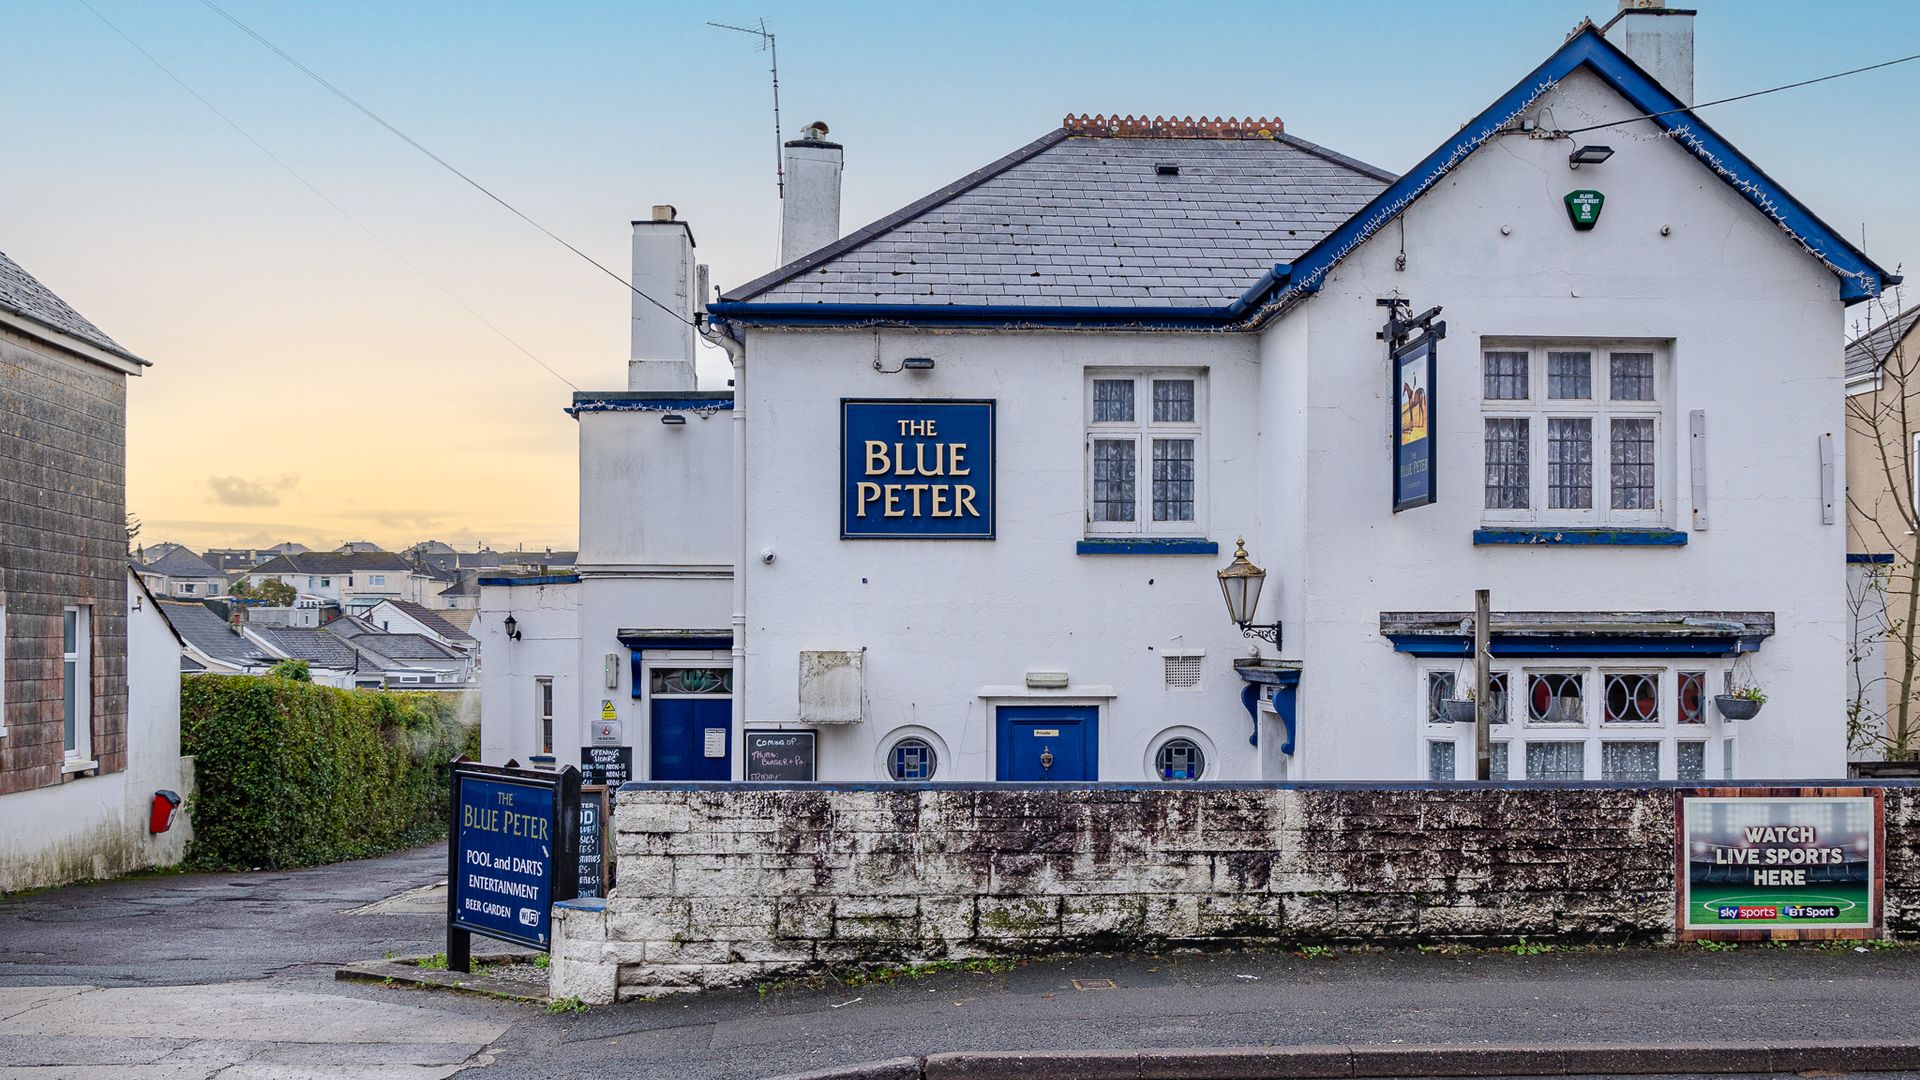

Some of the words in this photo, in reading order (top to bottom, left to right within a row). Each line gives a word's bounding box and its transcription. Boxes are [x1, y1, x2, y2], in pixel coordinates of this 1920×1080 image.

[897, 420, 937, 436] THE
[864, 440, 970, 476] BLUE
[1413, 458, 1429, 474] PETER
[856, 482, 981, 517] PETER
[591, 749, 619, 757] OPENING
[497, 791, 513, 806] THE
[464, 804, 499, 832] BLUE
[503, 810, 548, 840] PETER
[579, 835, 595, 844] SICS
[1745, 826, 1814, 843] WATCH
[466, 849, 492, 868] POOL
[494, 856, 510, 870] and
[513, 857, 543, 877] DARTS
[1716, 848, 1760, 865] LIVE
[1765, 848, 1843, 865] SPORTS
[1753, 869, 1806, 886] HERE
[469, 874, 539, 901] ENTERTAINMENT
[465, 898, 482, 912] BEER
[482, 902, 511, 918] GARDEN
[1720, 908, 1738, 919] sky
[1740, 908, 1775, 919] sports
[1789, 907, 1805, 917] BT
[1806, 907, 1834, 918] Sport
